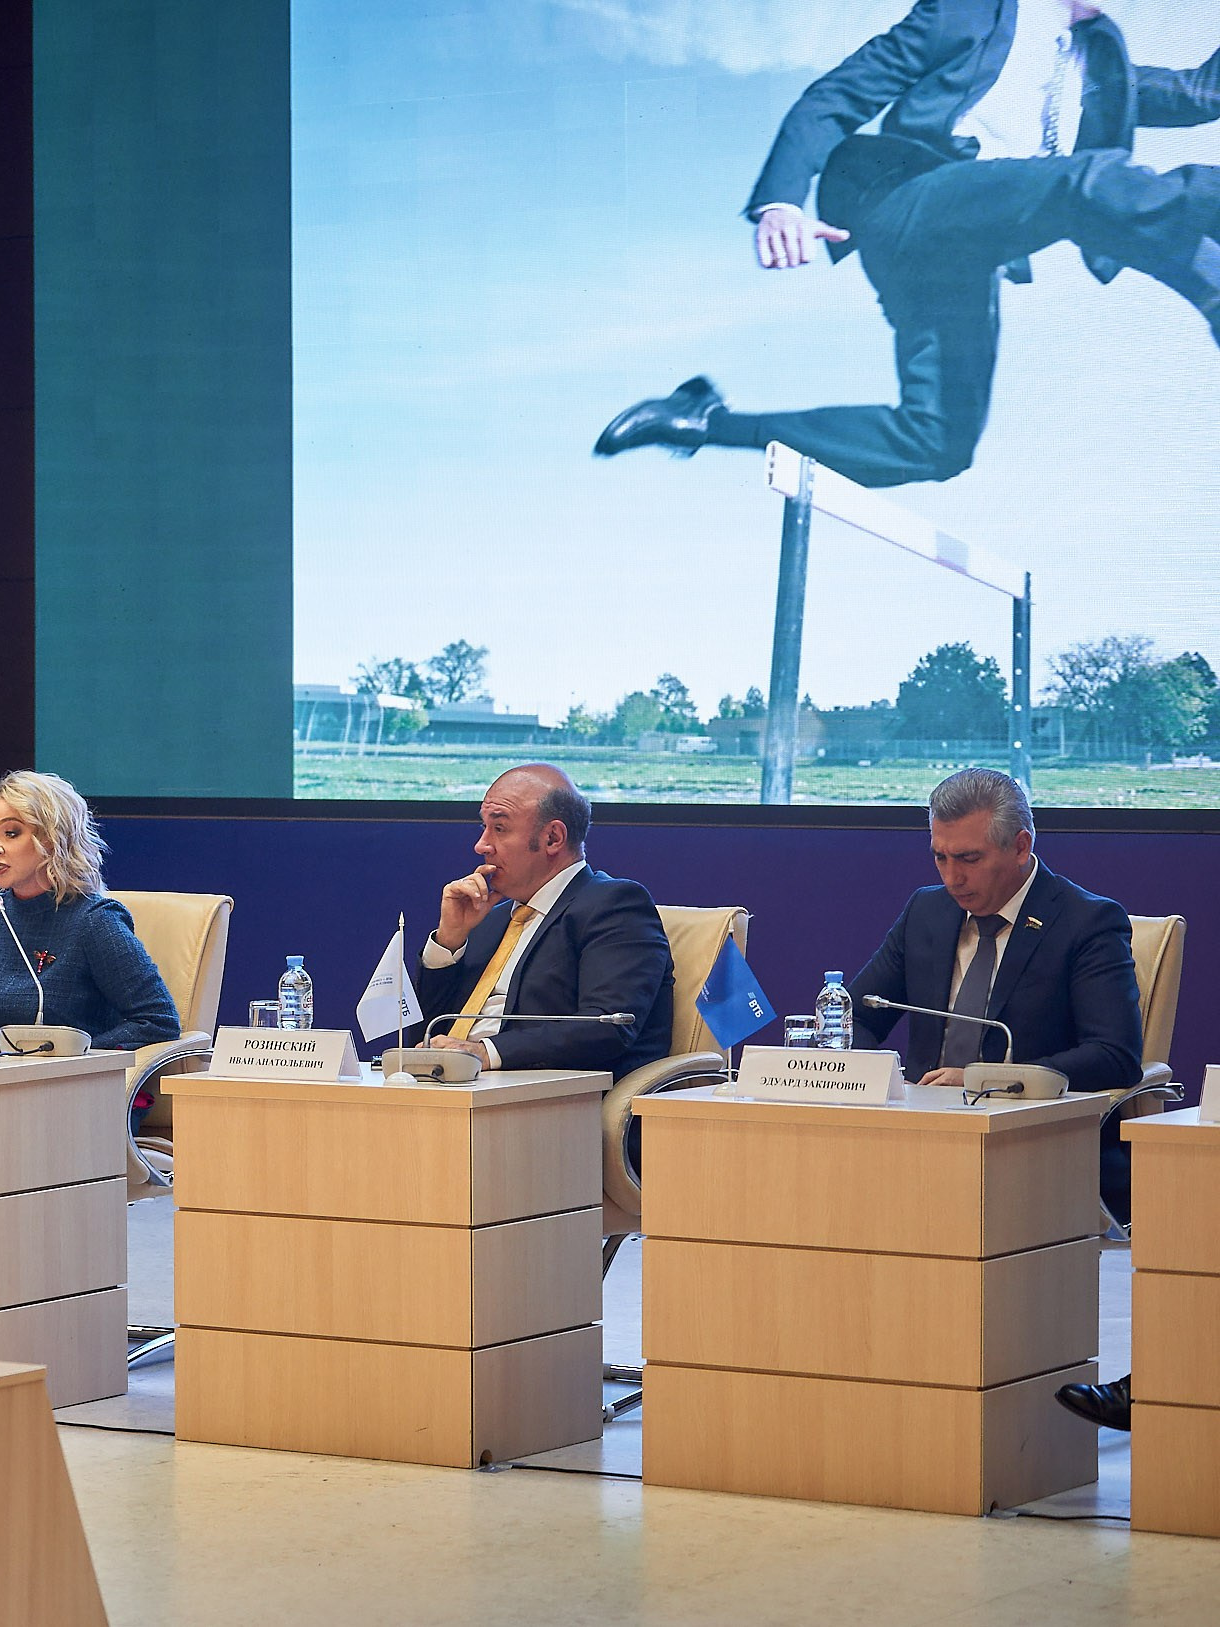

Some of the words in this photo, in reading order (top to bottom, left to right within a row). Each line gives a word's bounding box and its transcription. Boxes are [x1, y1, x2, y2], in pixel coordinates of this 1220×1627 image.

[748, 999, 764, 1018] ВТБ
[244, 1039, 316, 1052] РОЗИНСКИЙ
[229, 1056, 254, 1065] ИВАН
[256, 1058, 324, 1069] АНАТОЛЬЕВИЧ
[787, 1059, 846, 1073] ОМАРОВ
[760, 1077, 801, 1088] ЭДУАРД
[802, 1079, 866, 1091] ЗАКИРОВИЧ
